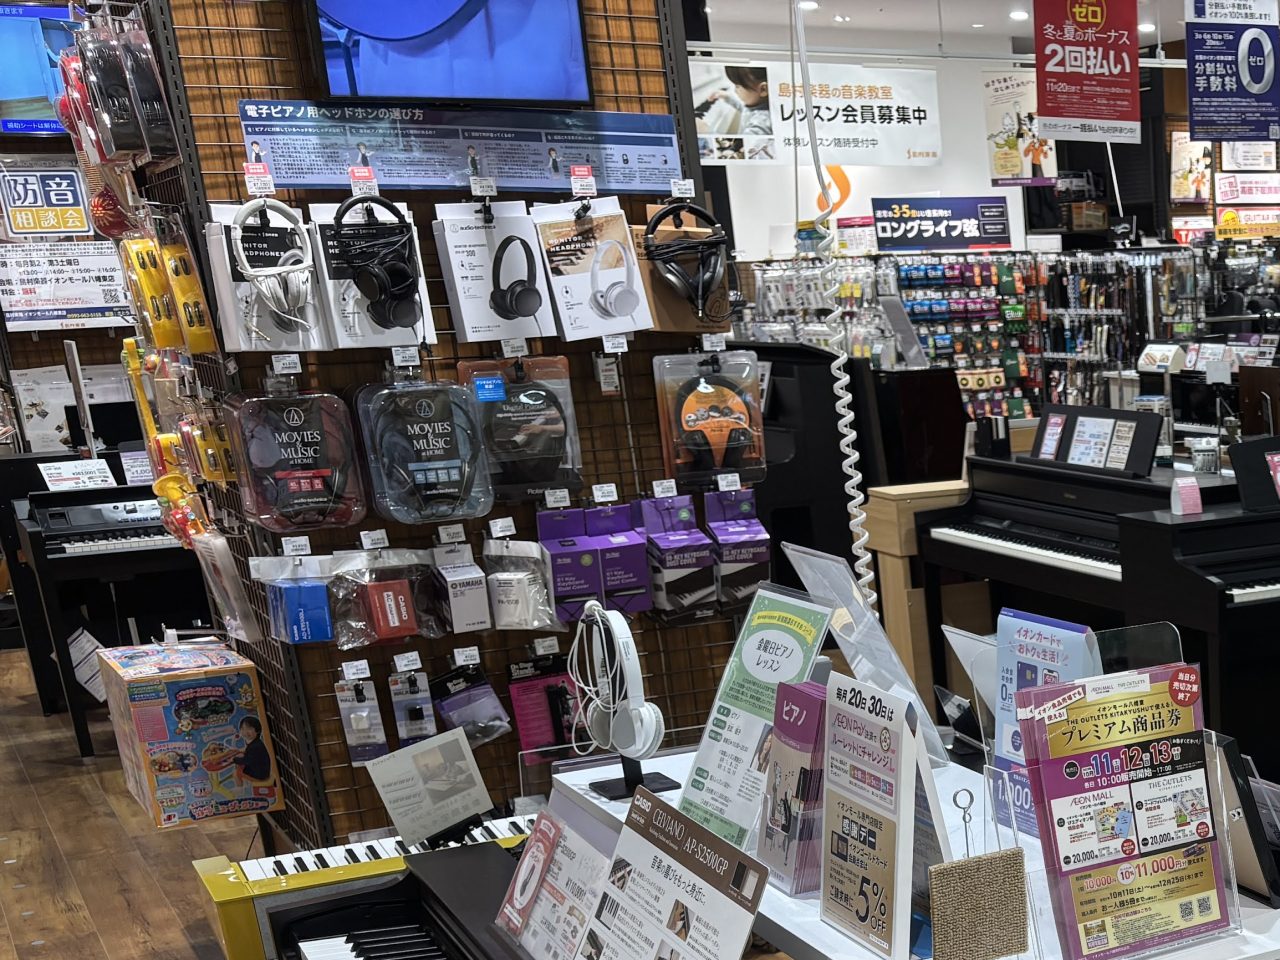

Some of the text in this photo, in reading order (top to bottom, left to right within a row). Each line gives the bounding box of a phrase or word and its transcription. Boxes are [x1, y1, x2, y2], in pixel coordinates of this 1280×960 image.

[1072, 4, 1102, 23] ゼロ
[1043, 23, 1131, 45] 冬と夏のボーナス
[1044, 43, 1131, 75] 2回払い
[1195, 63, 1236, 75] 分割払い
[1195, 76, 1237, 92] 手数料
[245, 105, 424, 121] 電子ピアノ用ヘッドホンの選び方
[781, 105, 927, 124] レッスン会員募集中
[11, 177, 75, 206] 防音
[14, 210, 83, 227] 相談会
[877, 220, 980, 238] ロングライフ弦
[550, 241, 601, 251] HEADPHONES
[407, 421, 451, 435] MOVIES
[275, 431, 321, 443] MOVIES
[413, 438, 450, 451] MUSIC
[281, 446, 320, 459] MUSIC
[458, 580, 483, 588] YAMAHA
[398, 595, 408, 620] CASIO
[1016, 627, 1063, 647] イオンカードで
[756, 638, 794, 659] 金曜日ピアノ
[756, 655, 781, 672] レッスン
[1178, 672, 1196, 682] 当日分
[1172, 682, 1199, 693] 売切次第
[848, 688, 867, 710] 20日
[868, 695, 894, 721] 30日は
[1037, 690, 1083, 716] イオン食品売場でも
[1177, 692, 1190, 701] 終了
[782, 700, 806, 726] ピアノ
[1046, 711, 1065, 721] 使える!
[1067, 718, 1079, 726] THE
[1080, 714, 1109, 724] OUTLETS
[1062, 709, 1181, 747] プレミアム商品券
[1090, 752, 1111, 776] 11
[1119, 747, 1143, 770] 12
[1150, 741, 1172, 764] 13
[1148, 774, 1193, 790] THE OUTLETS
[634, 795, 651, 812] CASIO
[1093, 791, 1114, 800] MALL
[653, 809, 685, 841] CELVIANO
[683, 837, 729, 876] AP-S2500GP
[871, 915, 887, 935] OFF
